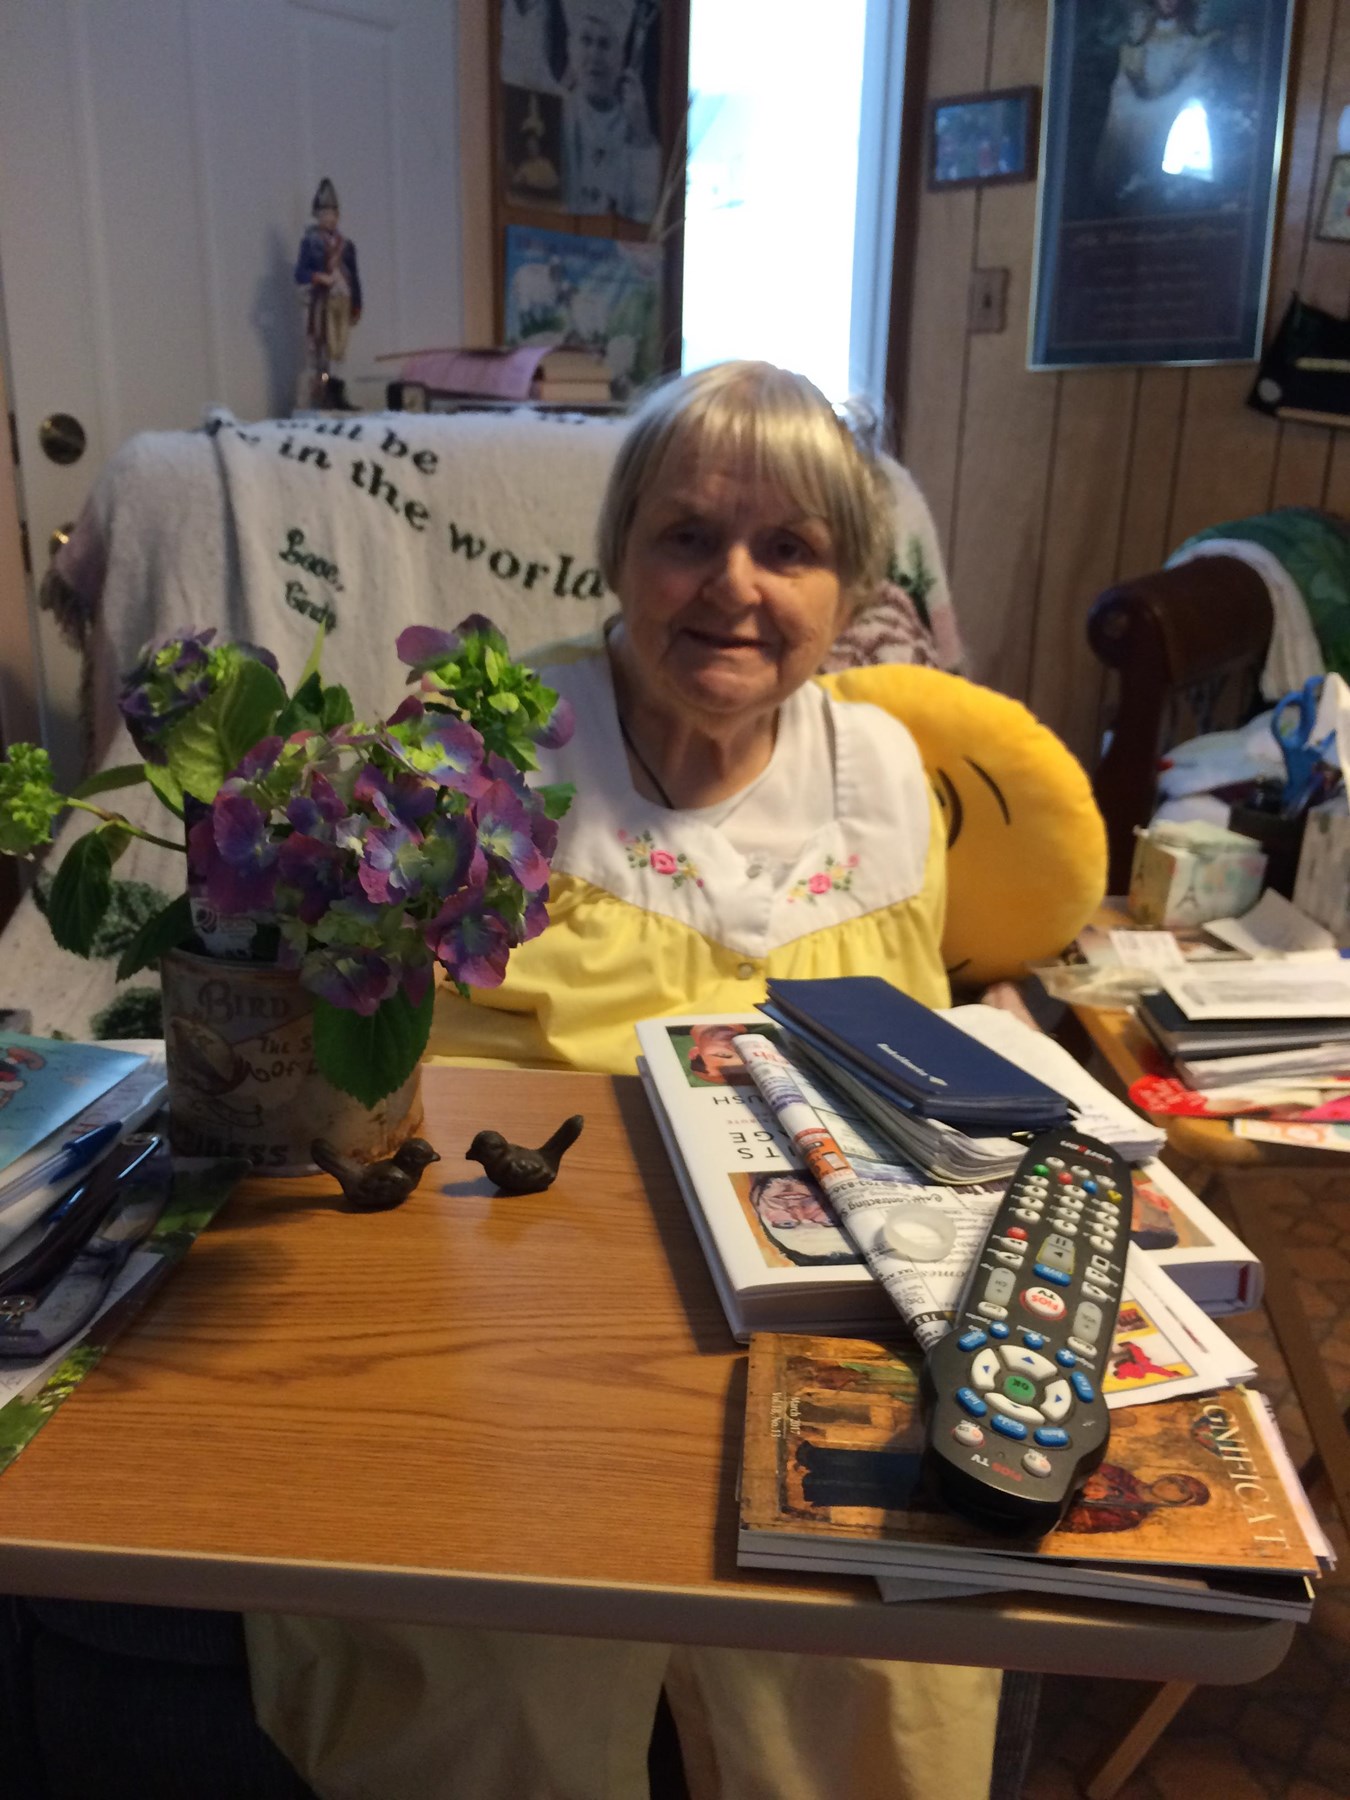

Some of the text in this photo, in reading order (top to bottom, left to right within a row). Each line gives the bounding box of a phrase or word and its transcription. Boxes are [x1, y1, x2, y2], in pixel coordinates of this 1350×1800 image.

[381, 426, 439, 475] be
[279, 434, 331, 469] in
[350, 457, 431, 532] the
[1013, 1379, 1029, 1391] OK
[790, 1396, 802, 1436] March 2017
[999, 1414, 1025, 1432] Guide
[970, 1453, 990, 1467] TV
